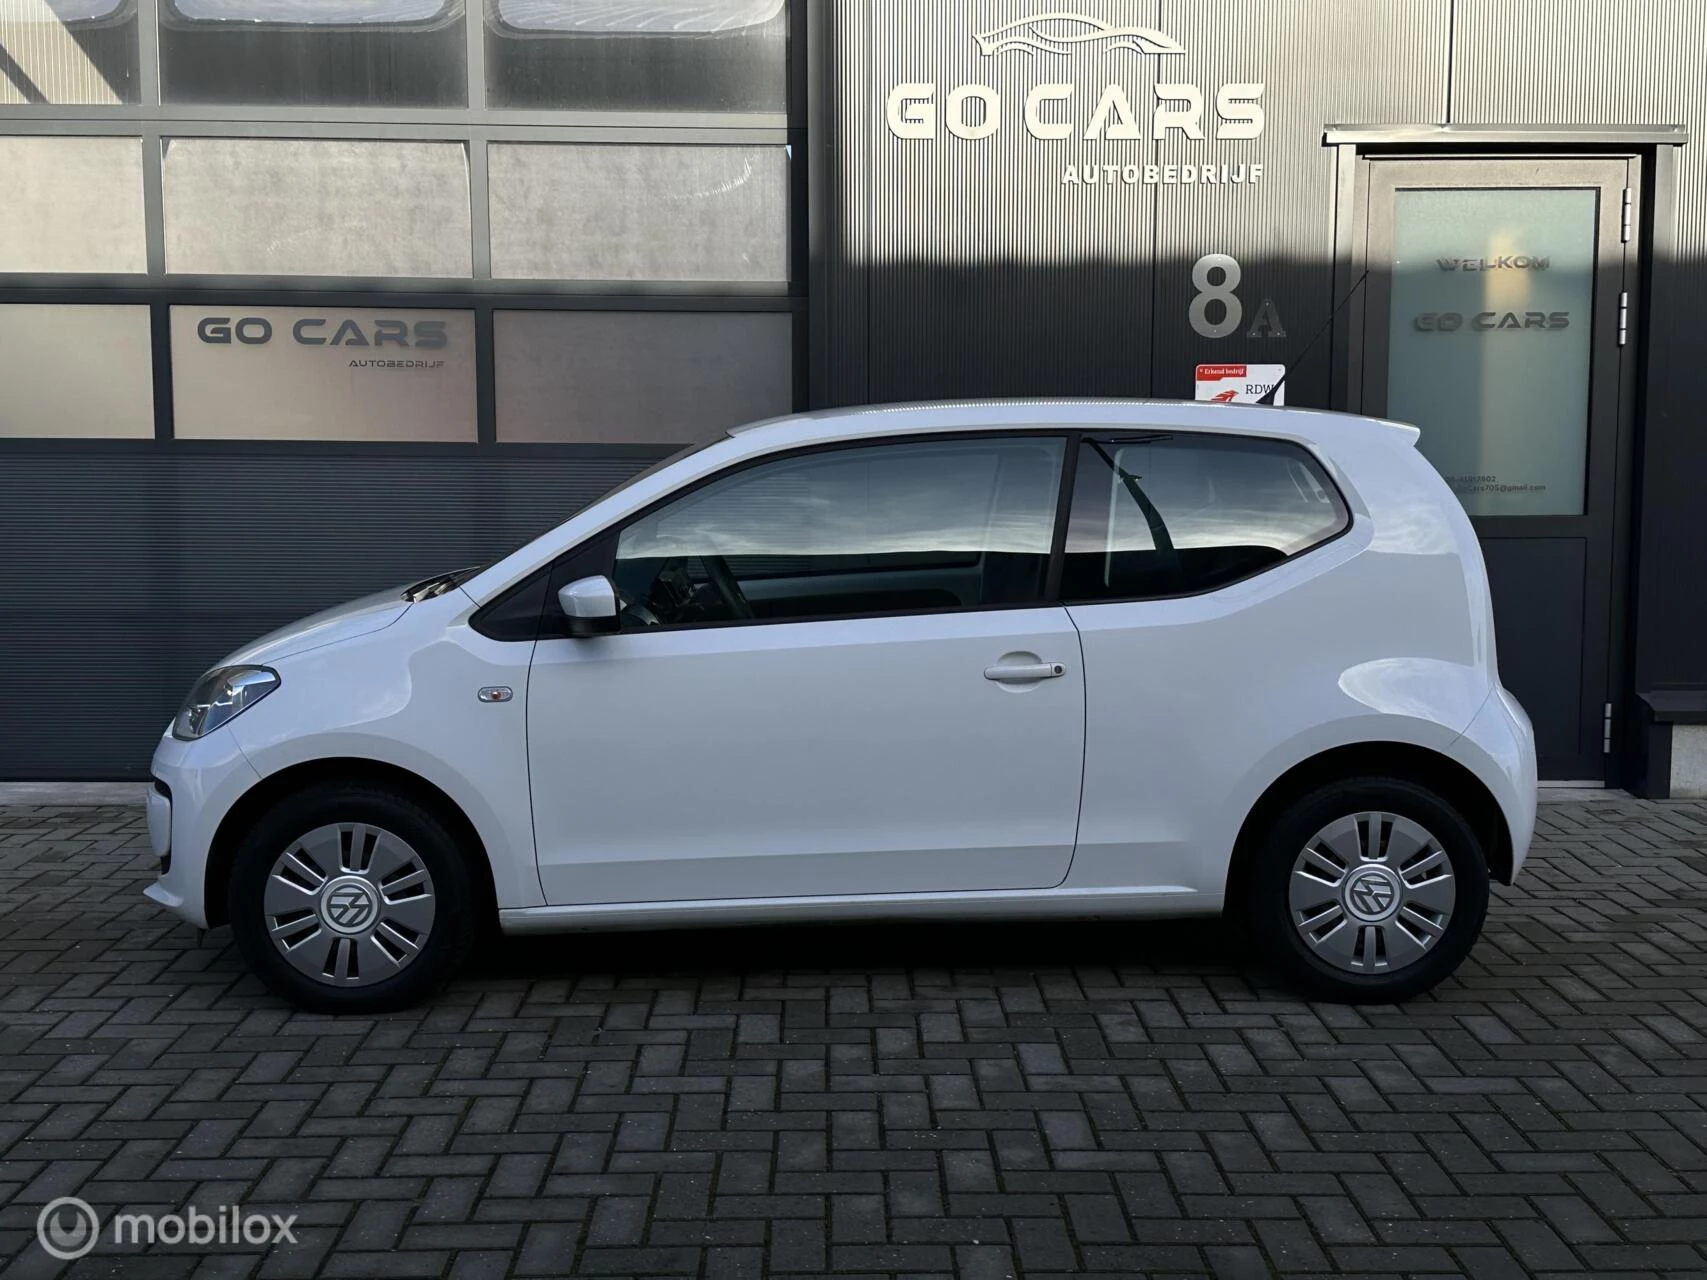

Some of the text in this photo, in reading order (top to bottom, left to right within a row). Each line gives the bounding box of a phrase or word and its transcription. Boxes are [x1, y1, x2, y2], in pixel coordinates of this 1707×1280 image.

[886, 82, 1266, 140] GO CARS
[1062, 163, 1264, 185] AUTOBEDRIJF
[1436, 255, 1550, 272] WELKOM
[1472, 312, 1570, 331] CARS
[197, 317, 448, 348] GO CARS
[349, 360, 445, 369] AUTOBEDRIJF
[1246, 384, 1275, 395] RDW
